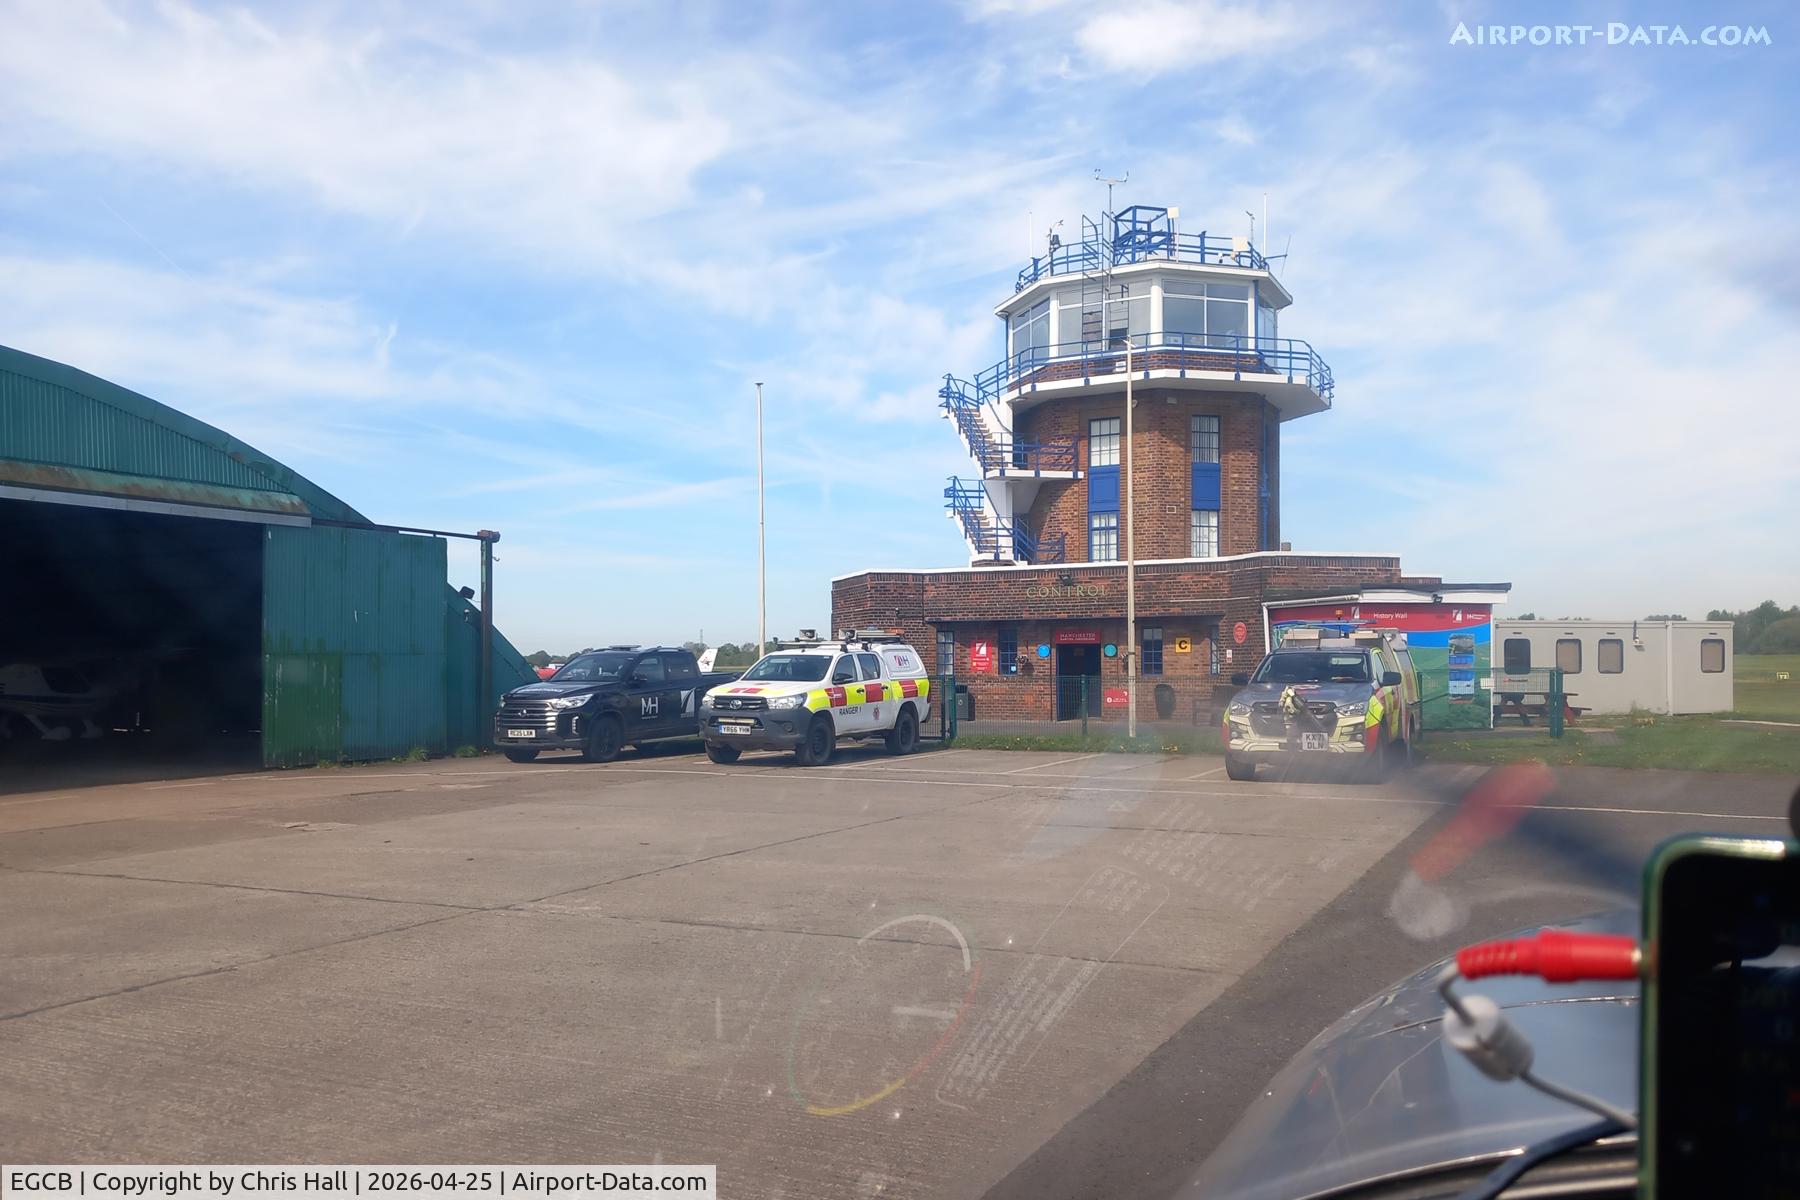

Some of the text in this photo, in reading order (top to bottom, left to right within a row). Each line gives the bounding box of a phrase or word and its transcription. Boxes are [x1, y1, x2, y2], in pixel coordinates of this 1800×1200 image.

[1026, 584, 1107, 598] CONTROL
[1373, 612, 1394, 620] History
[1178, 640, 1188, 650] C
[641, 696, 659, 716] MH
[839, 705, 858, 716] RANGER
